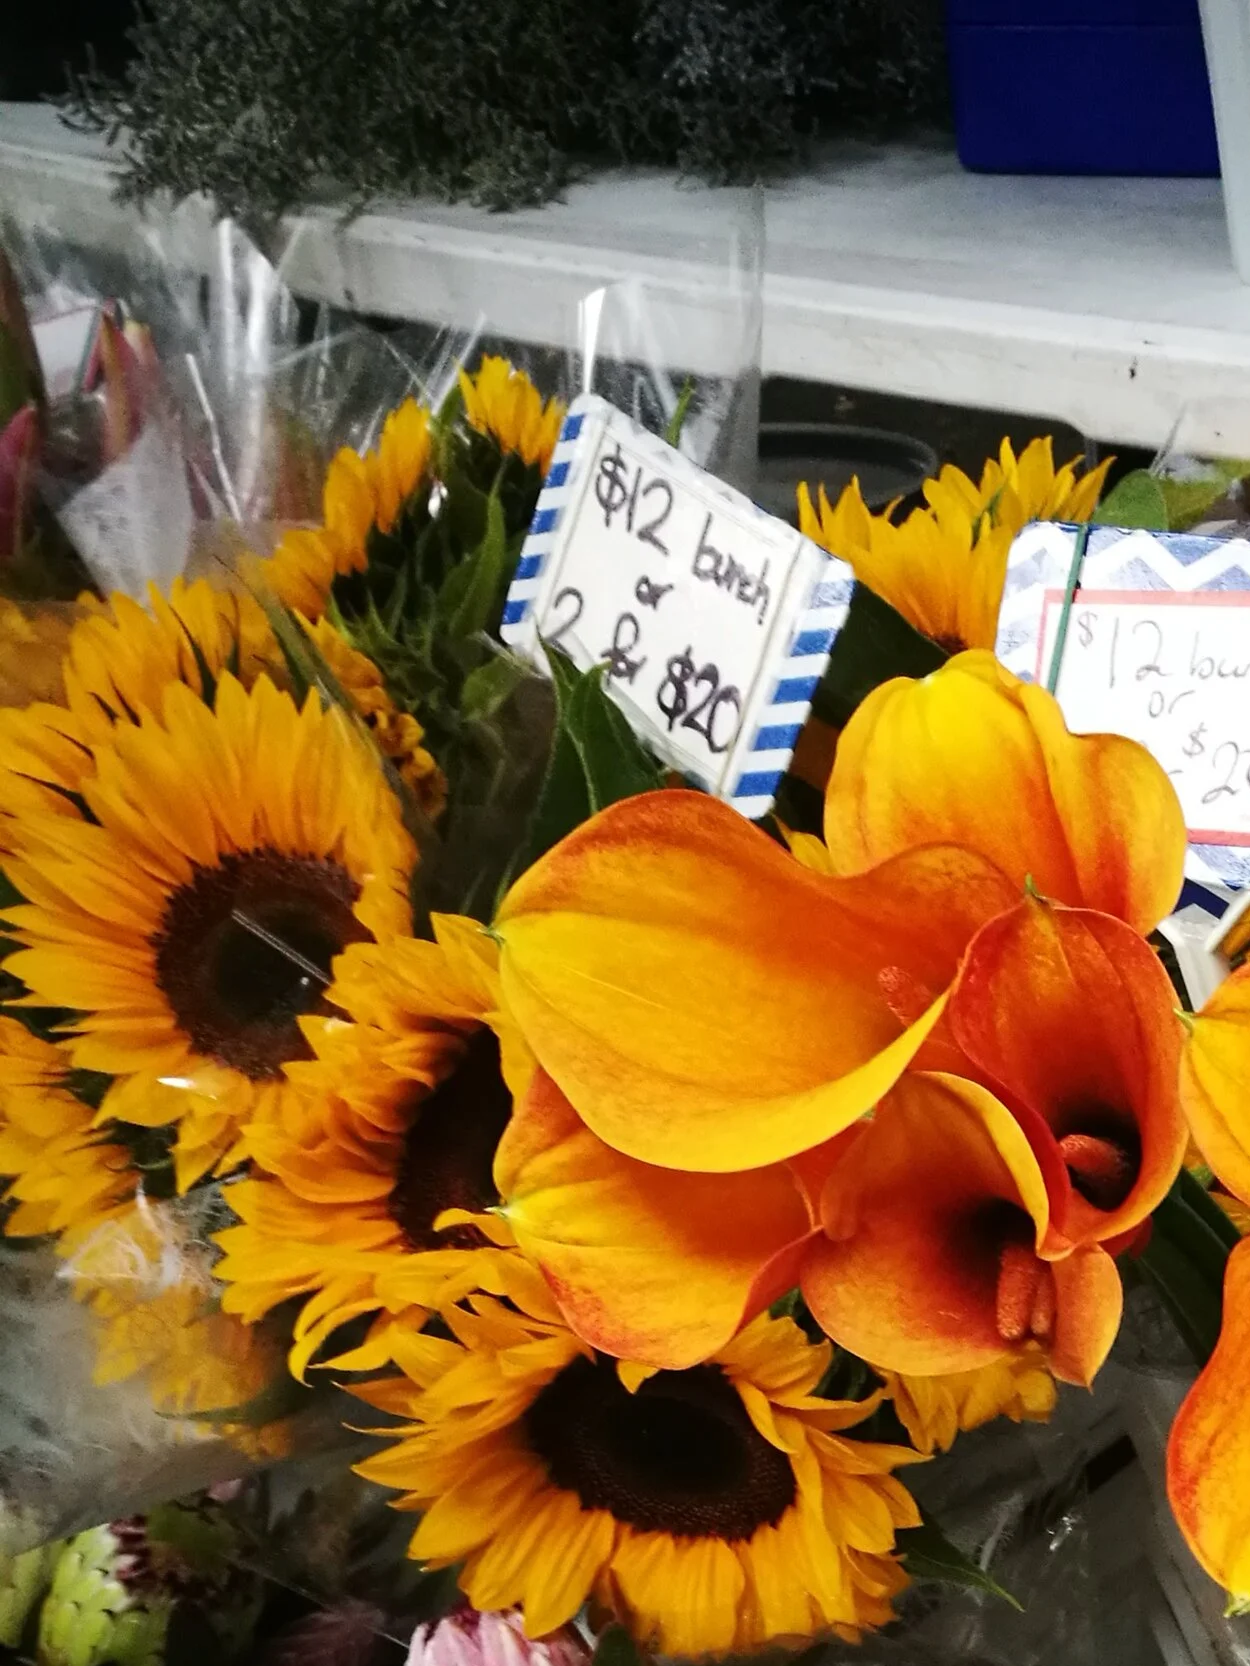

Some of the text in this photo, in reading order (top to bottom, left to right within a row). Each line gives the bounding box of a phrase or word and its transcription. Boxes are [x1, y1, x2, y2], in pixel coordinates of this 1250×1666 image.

[595, 442, 771, 626] $12 bunch
[635, 575, 674, 610] or
[545, 586, 740, 754] 2 for $20
[1078, 612, 1173, 688] $12
[1148, 689, 1195, 718] or
